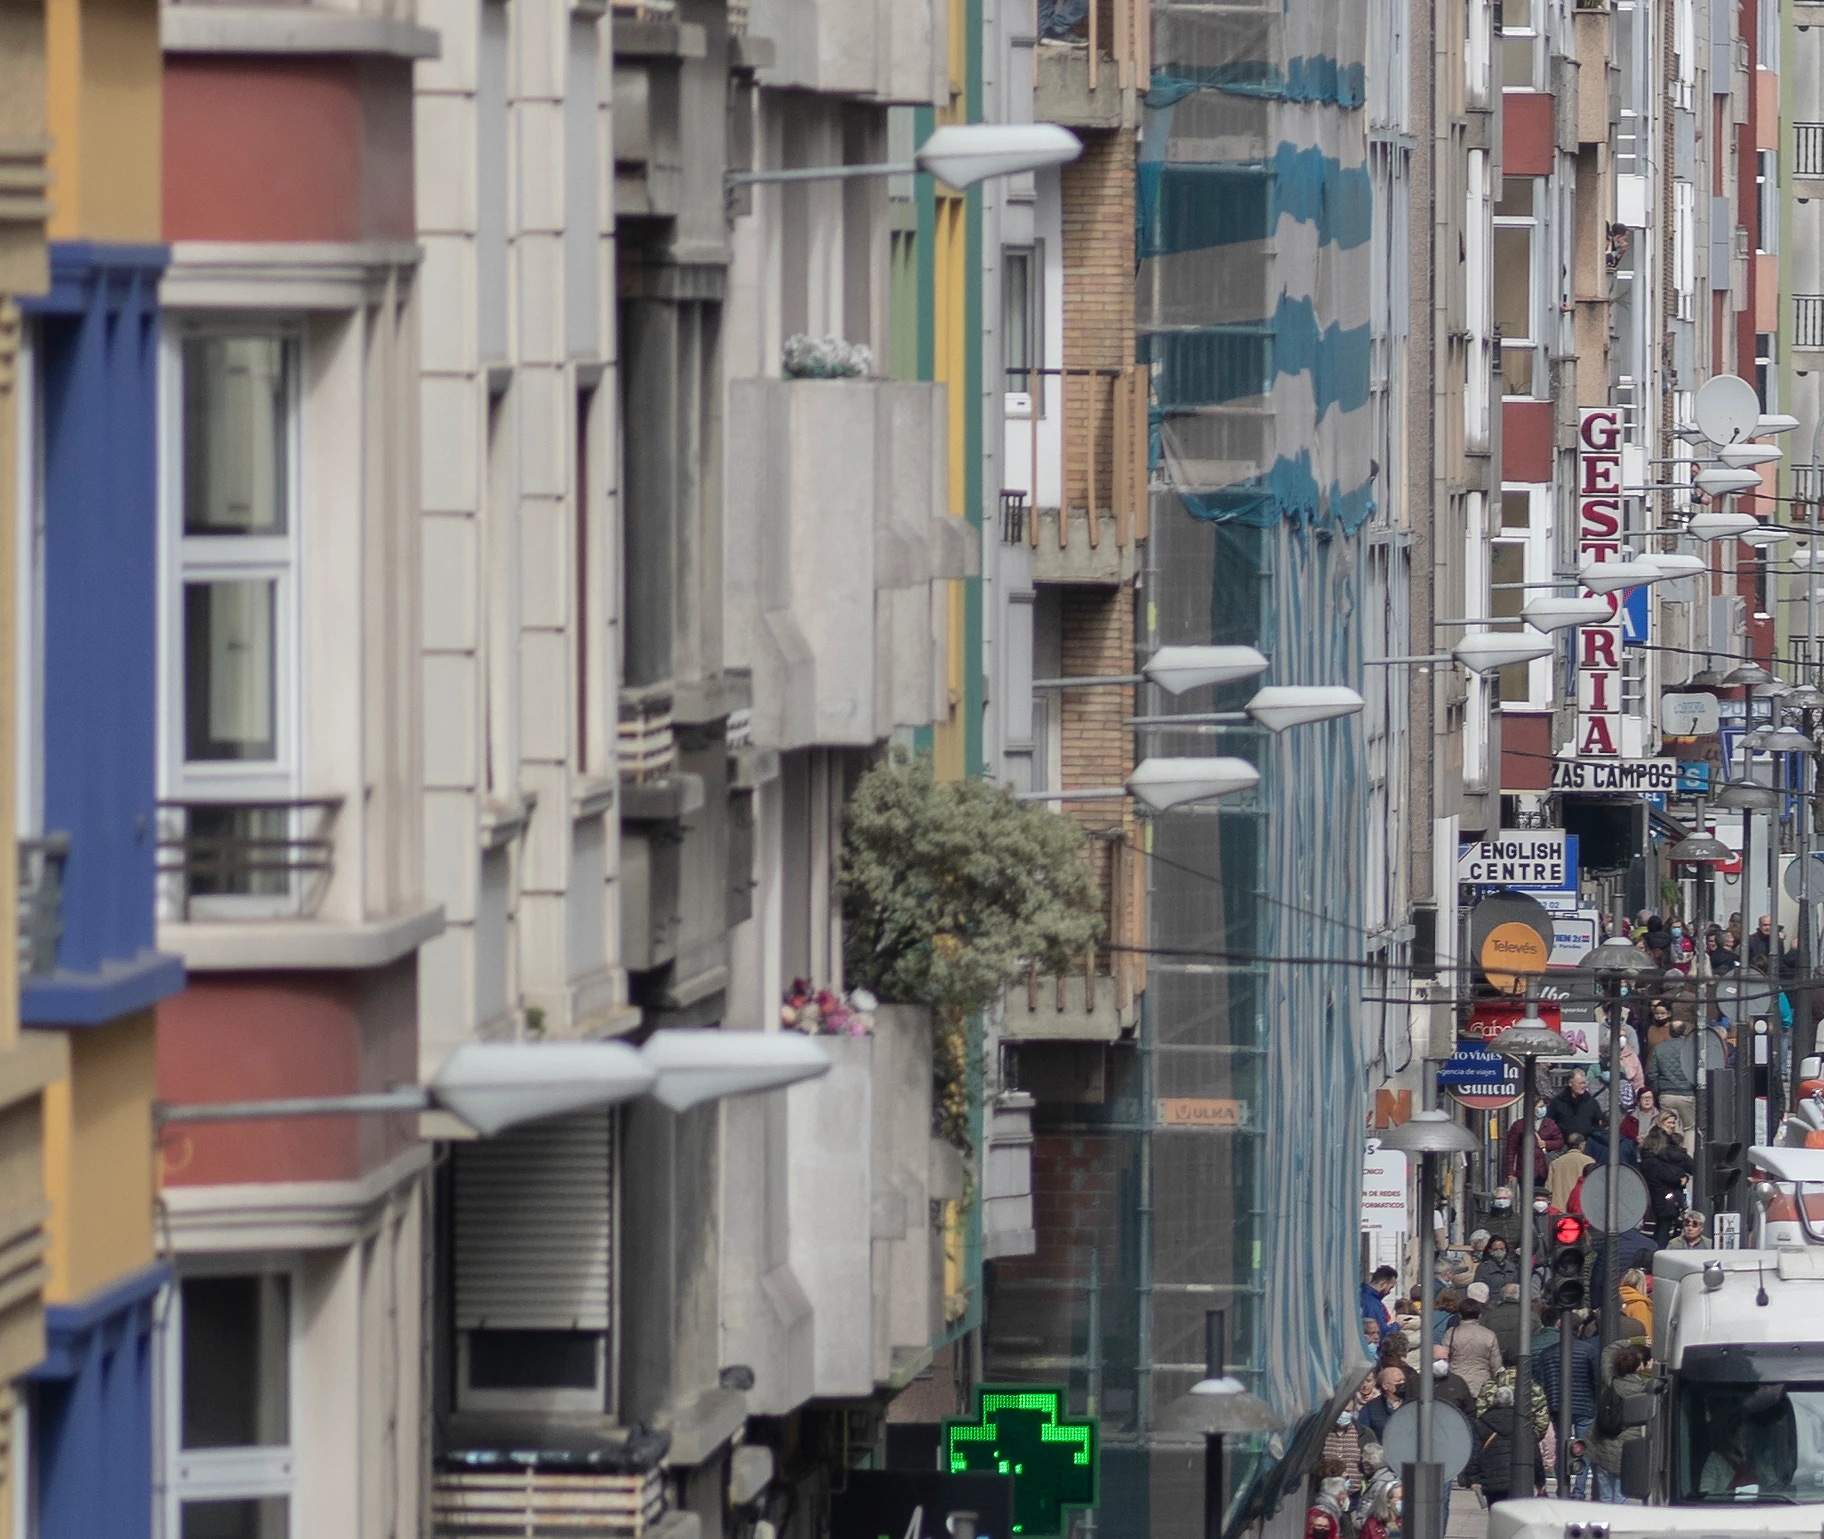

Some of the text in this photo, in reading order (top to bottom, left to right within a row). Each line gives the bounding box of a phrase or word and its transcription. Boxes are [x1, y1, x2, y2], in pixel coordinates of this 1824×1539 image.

[1594, 762, 1673, 788] CAMPOS
[1480, 842, 1562, 860] ENGLISH
[1470, 863, 1562, 881] CENTRE
[1492, 940, 1538, 954] Televés
